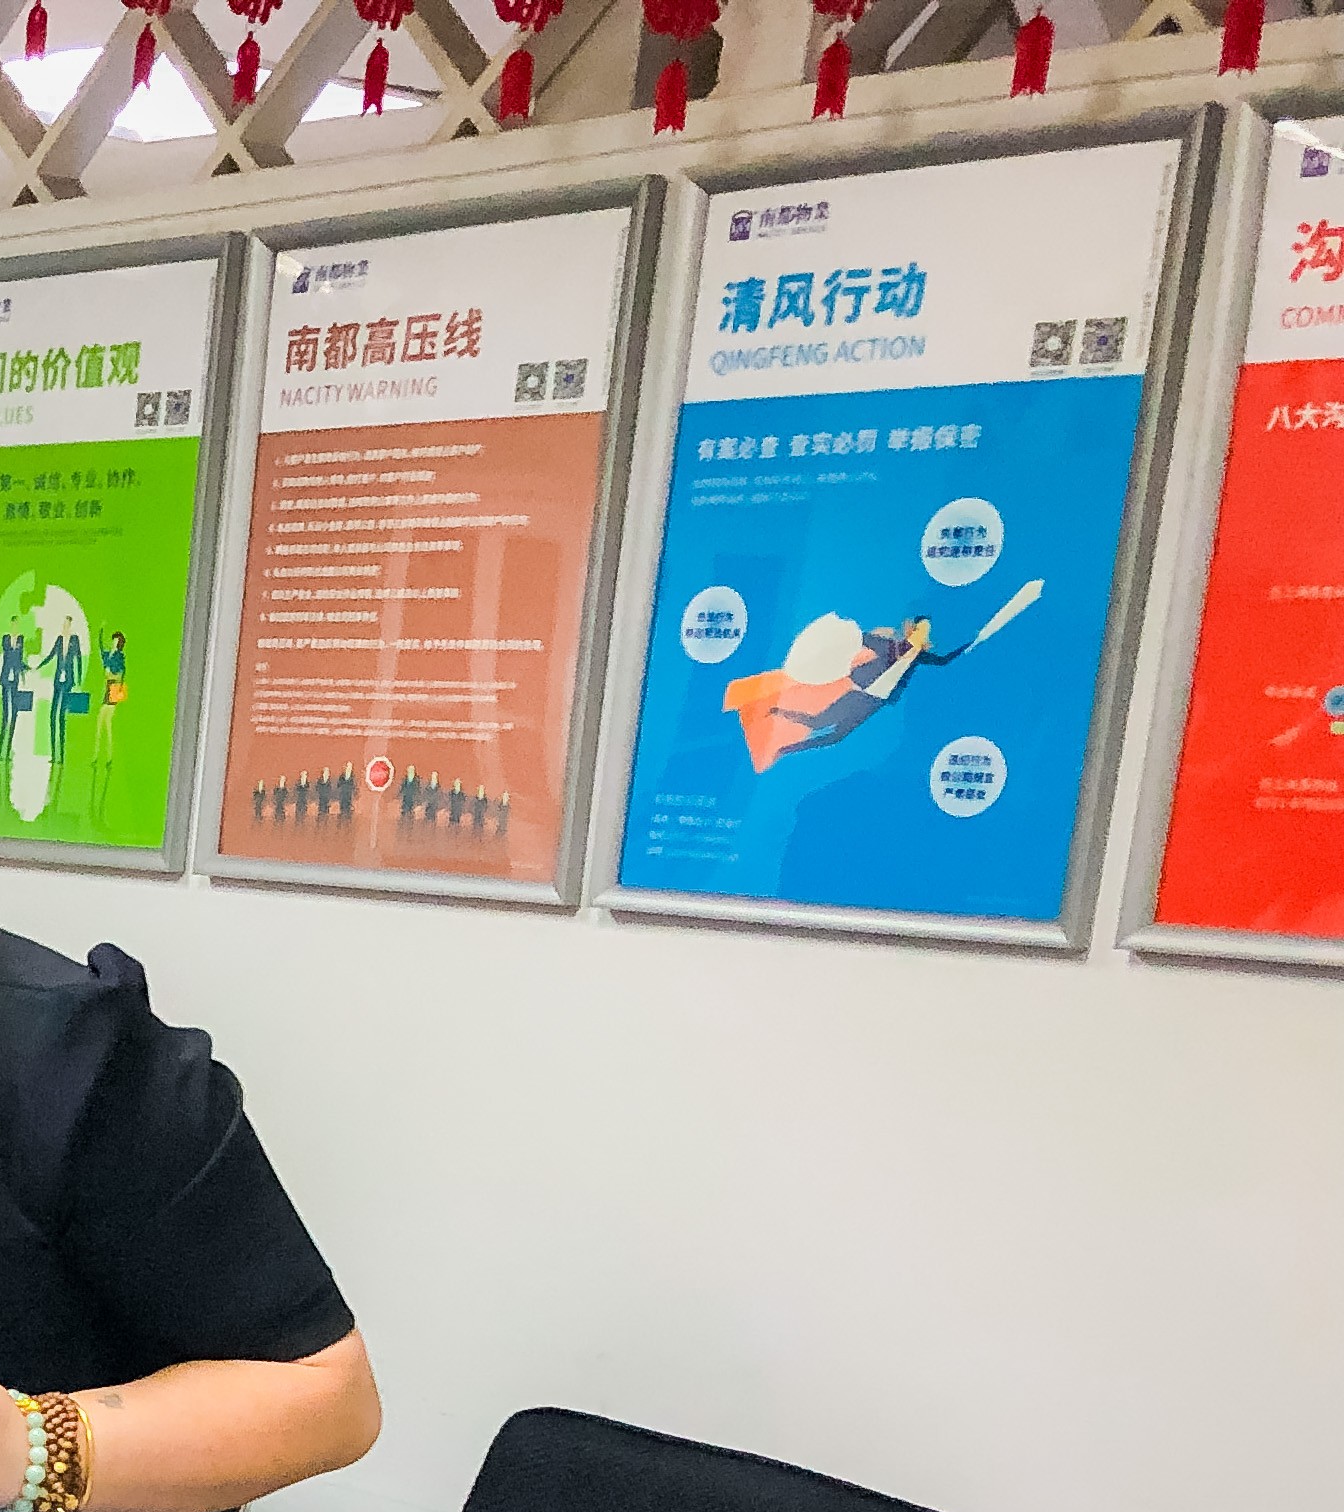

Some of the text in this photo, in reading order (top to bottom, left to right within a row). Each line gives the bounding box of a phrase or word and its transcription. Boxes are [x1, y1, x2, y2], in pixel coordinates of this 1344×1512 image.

[719, 261, 928, 334] 清风行动
[284, 308, 484, 375] 南都高压线
[711, 334, 927, 376] QINGFENG ACTION
[279, 375, 439, 408] NACITY WARNING
